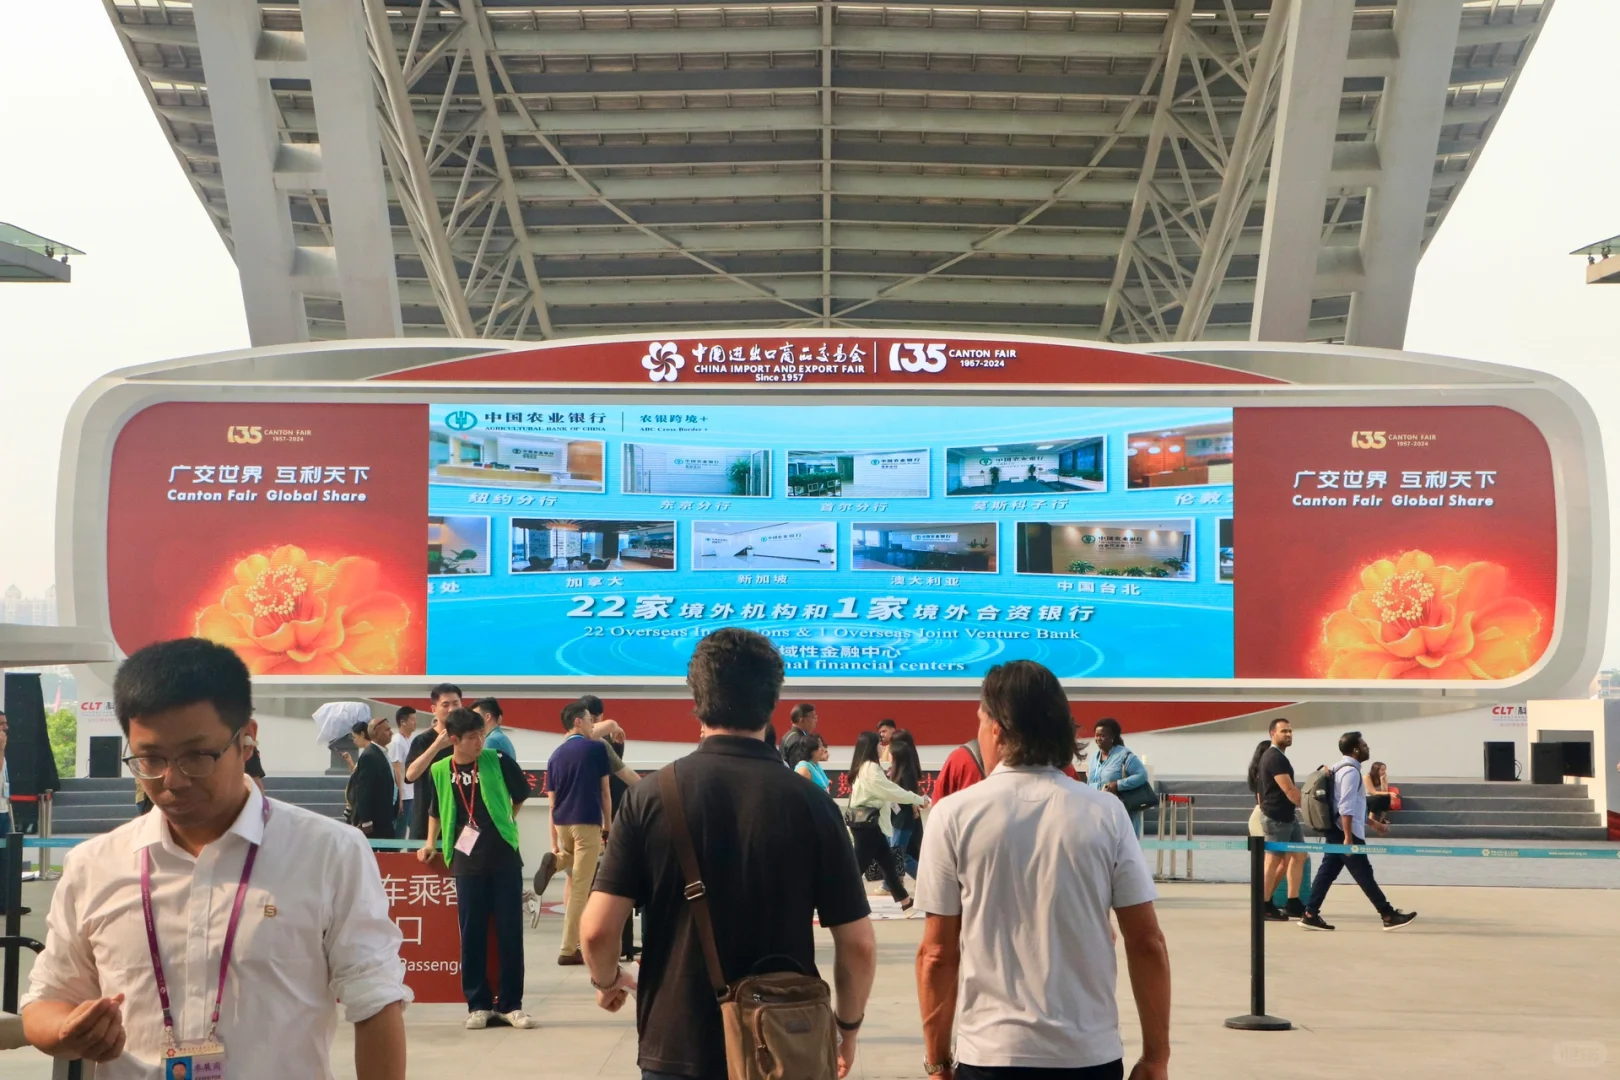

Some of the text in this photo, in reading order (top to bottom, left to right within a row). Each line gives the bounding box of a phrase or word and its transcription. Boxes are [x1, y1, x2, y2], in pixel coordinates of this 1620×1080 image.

[948, 349, 1017, 358] CANTON FAIR
[694, 365, 865, 373] CHINA IMPORT AND EXPORT FAIR
[755, 373, 804, 382] Since 1957
[485, 412, 607, 424] 中国农业银行
[168, 465, 370, 484] 广交世界 互利天下
[1293, 470, 1497, 489] 广交世界 互利天下
[167, 489, 367, 502] Canton Fair Global Share
[468, 491, 558, 507] 纽约分行
[1292, 494, 1494, 507] Canton Fair Global Share
[660, 500, 731, 511] 东京分行
[820, 502, 889, 512] 首尔分行
[972, 498, 1069, 511] 莫斯科子行
[566, 576, 624, 588] 加拿大
[737, 575, 789, 585] 新加坡
[891, 575, 960, 587] 澳大利亚
[1057, 581, 1142, 595] 中国台北
[584, 626, 604, 637] 22
[610, 625, 688, 637] Overseas
[796, 626, 812, 637] &
[834, 626, 911, 638] Overseas
[918, 627, 959, 640] Joint
[964, 627, 1029, 639] Venture
[1036, 628, 1080, 639] Bank
[815, 659, 894, 671] financial
[900, 661, 965, 671] centers
[81, 702, 103, 710] CLT
[1492, 706, 1514, 715] CLT
[400, 957, 462, 976] Passeng
